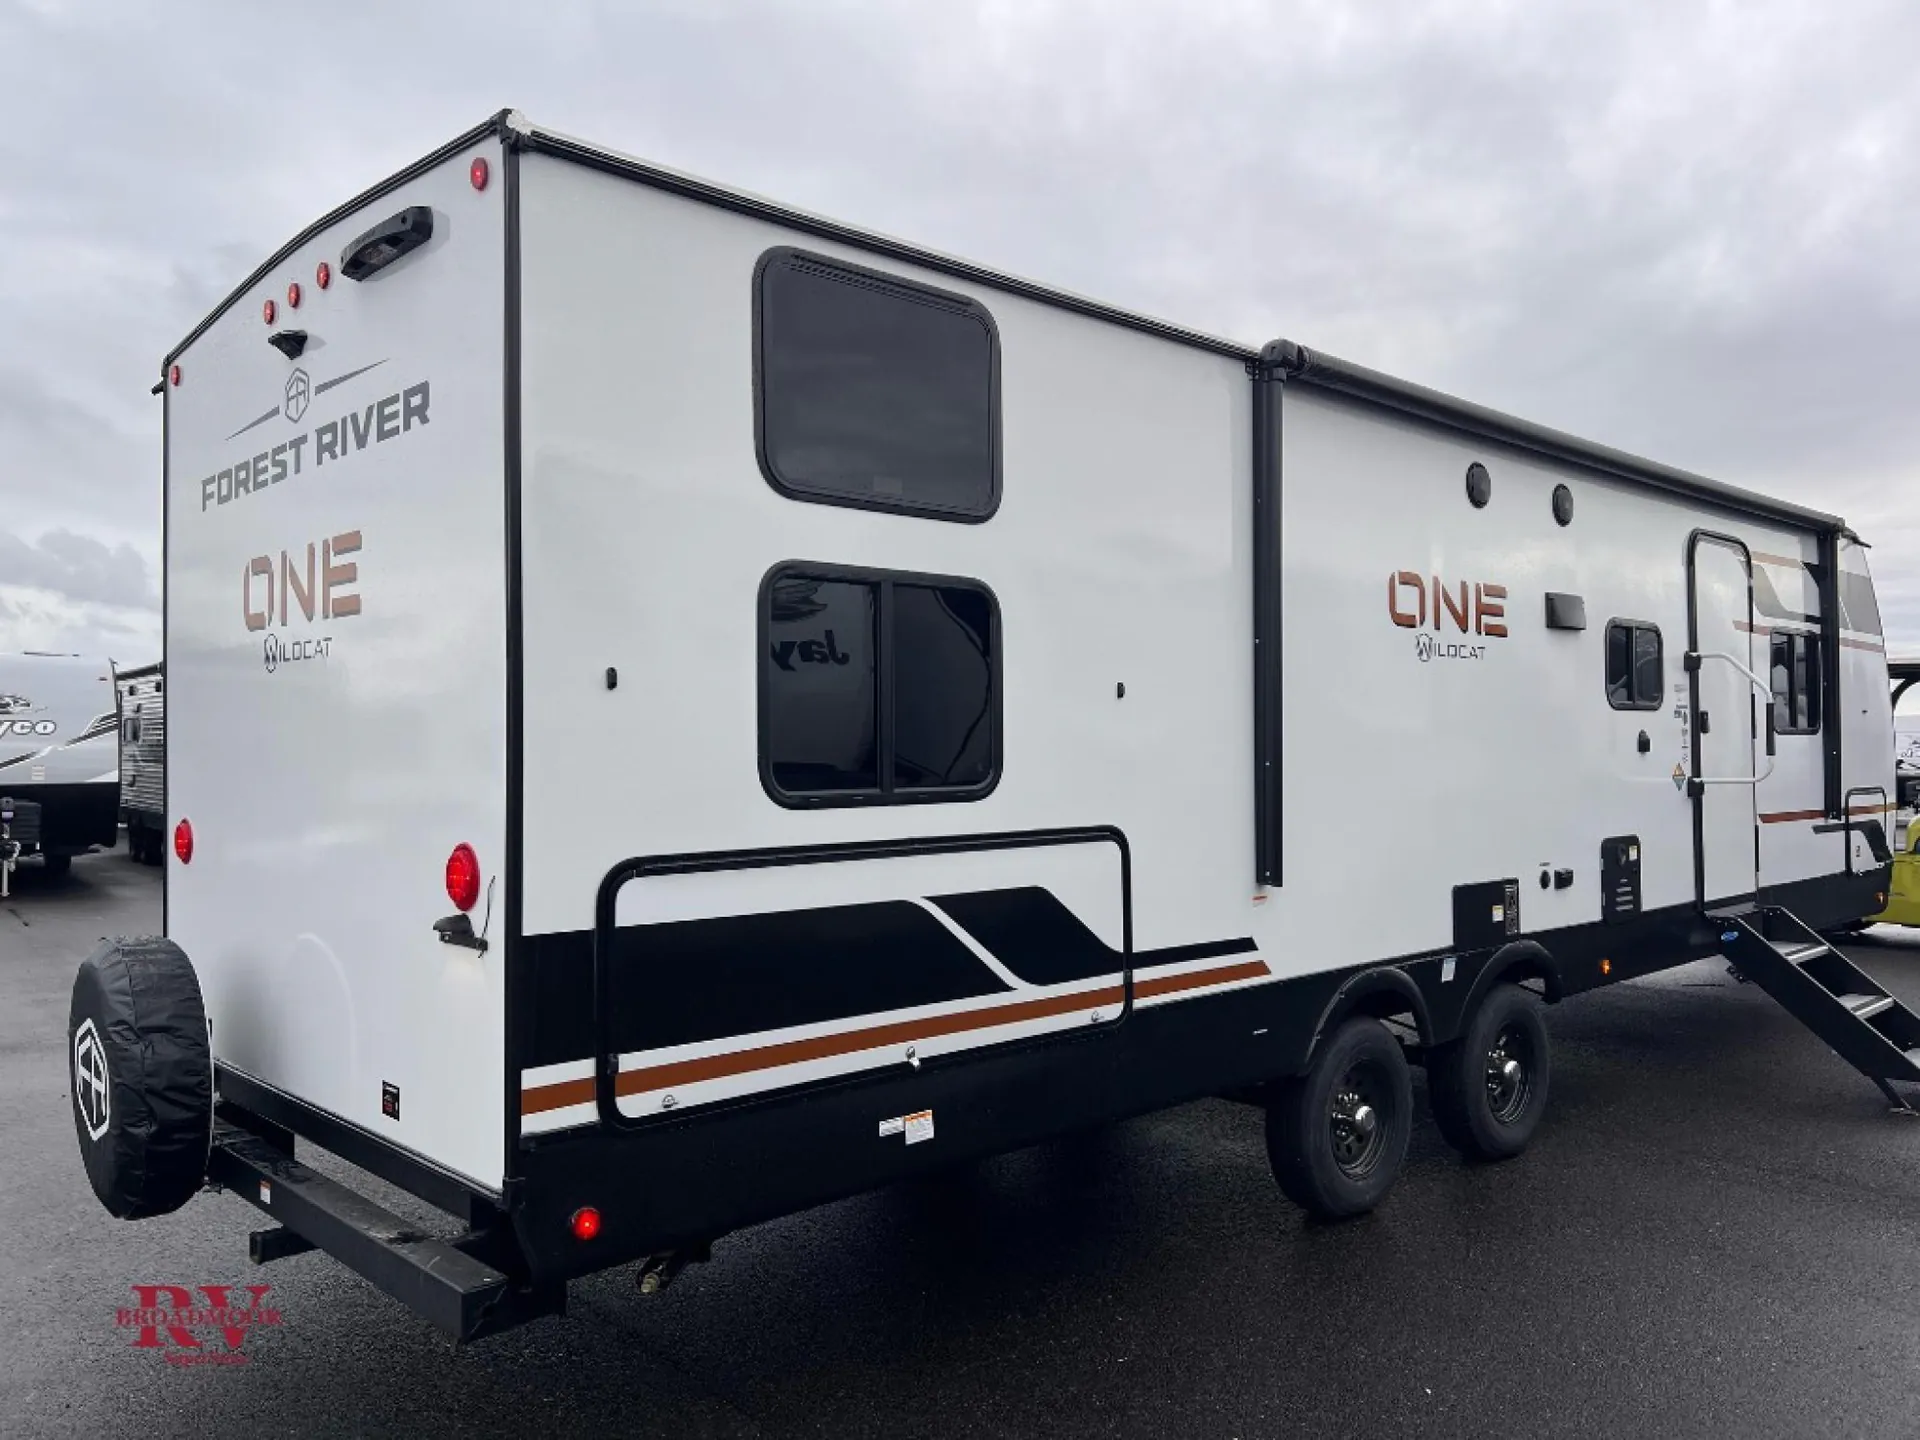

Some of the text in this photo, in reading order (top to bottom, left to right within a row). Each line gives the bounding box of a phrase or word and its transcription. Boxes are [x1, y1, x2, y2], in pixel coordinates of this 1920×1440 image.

[201, 380, 430, 512] FOREST RIVER
[243, 530, 362, 632] ONE
[1388, 570, 1508, 638] ONE
